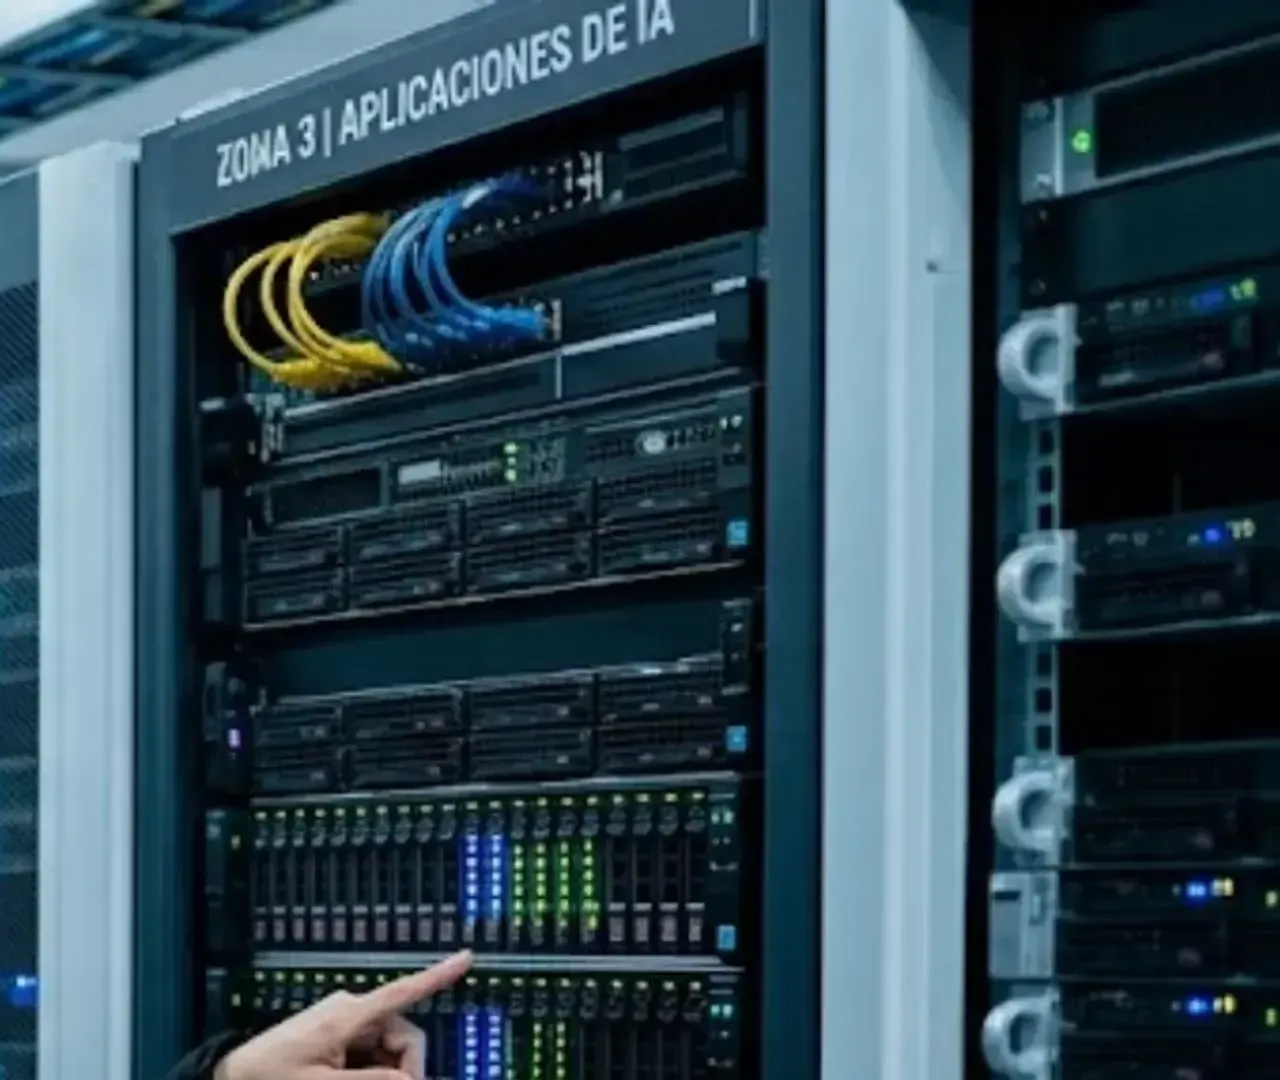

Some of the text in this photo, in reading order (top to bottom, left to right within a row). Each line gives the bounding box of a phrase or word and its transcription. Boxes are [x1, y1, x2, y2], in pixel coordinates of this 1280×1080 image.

[297, 113, 316, 160] 3
[339, 23, 572, 146] APLICACIONES
[581, 4, 628, 63] DE
[636, 0, 675, 45] IA
